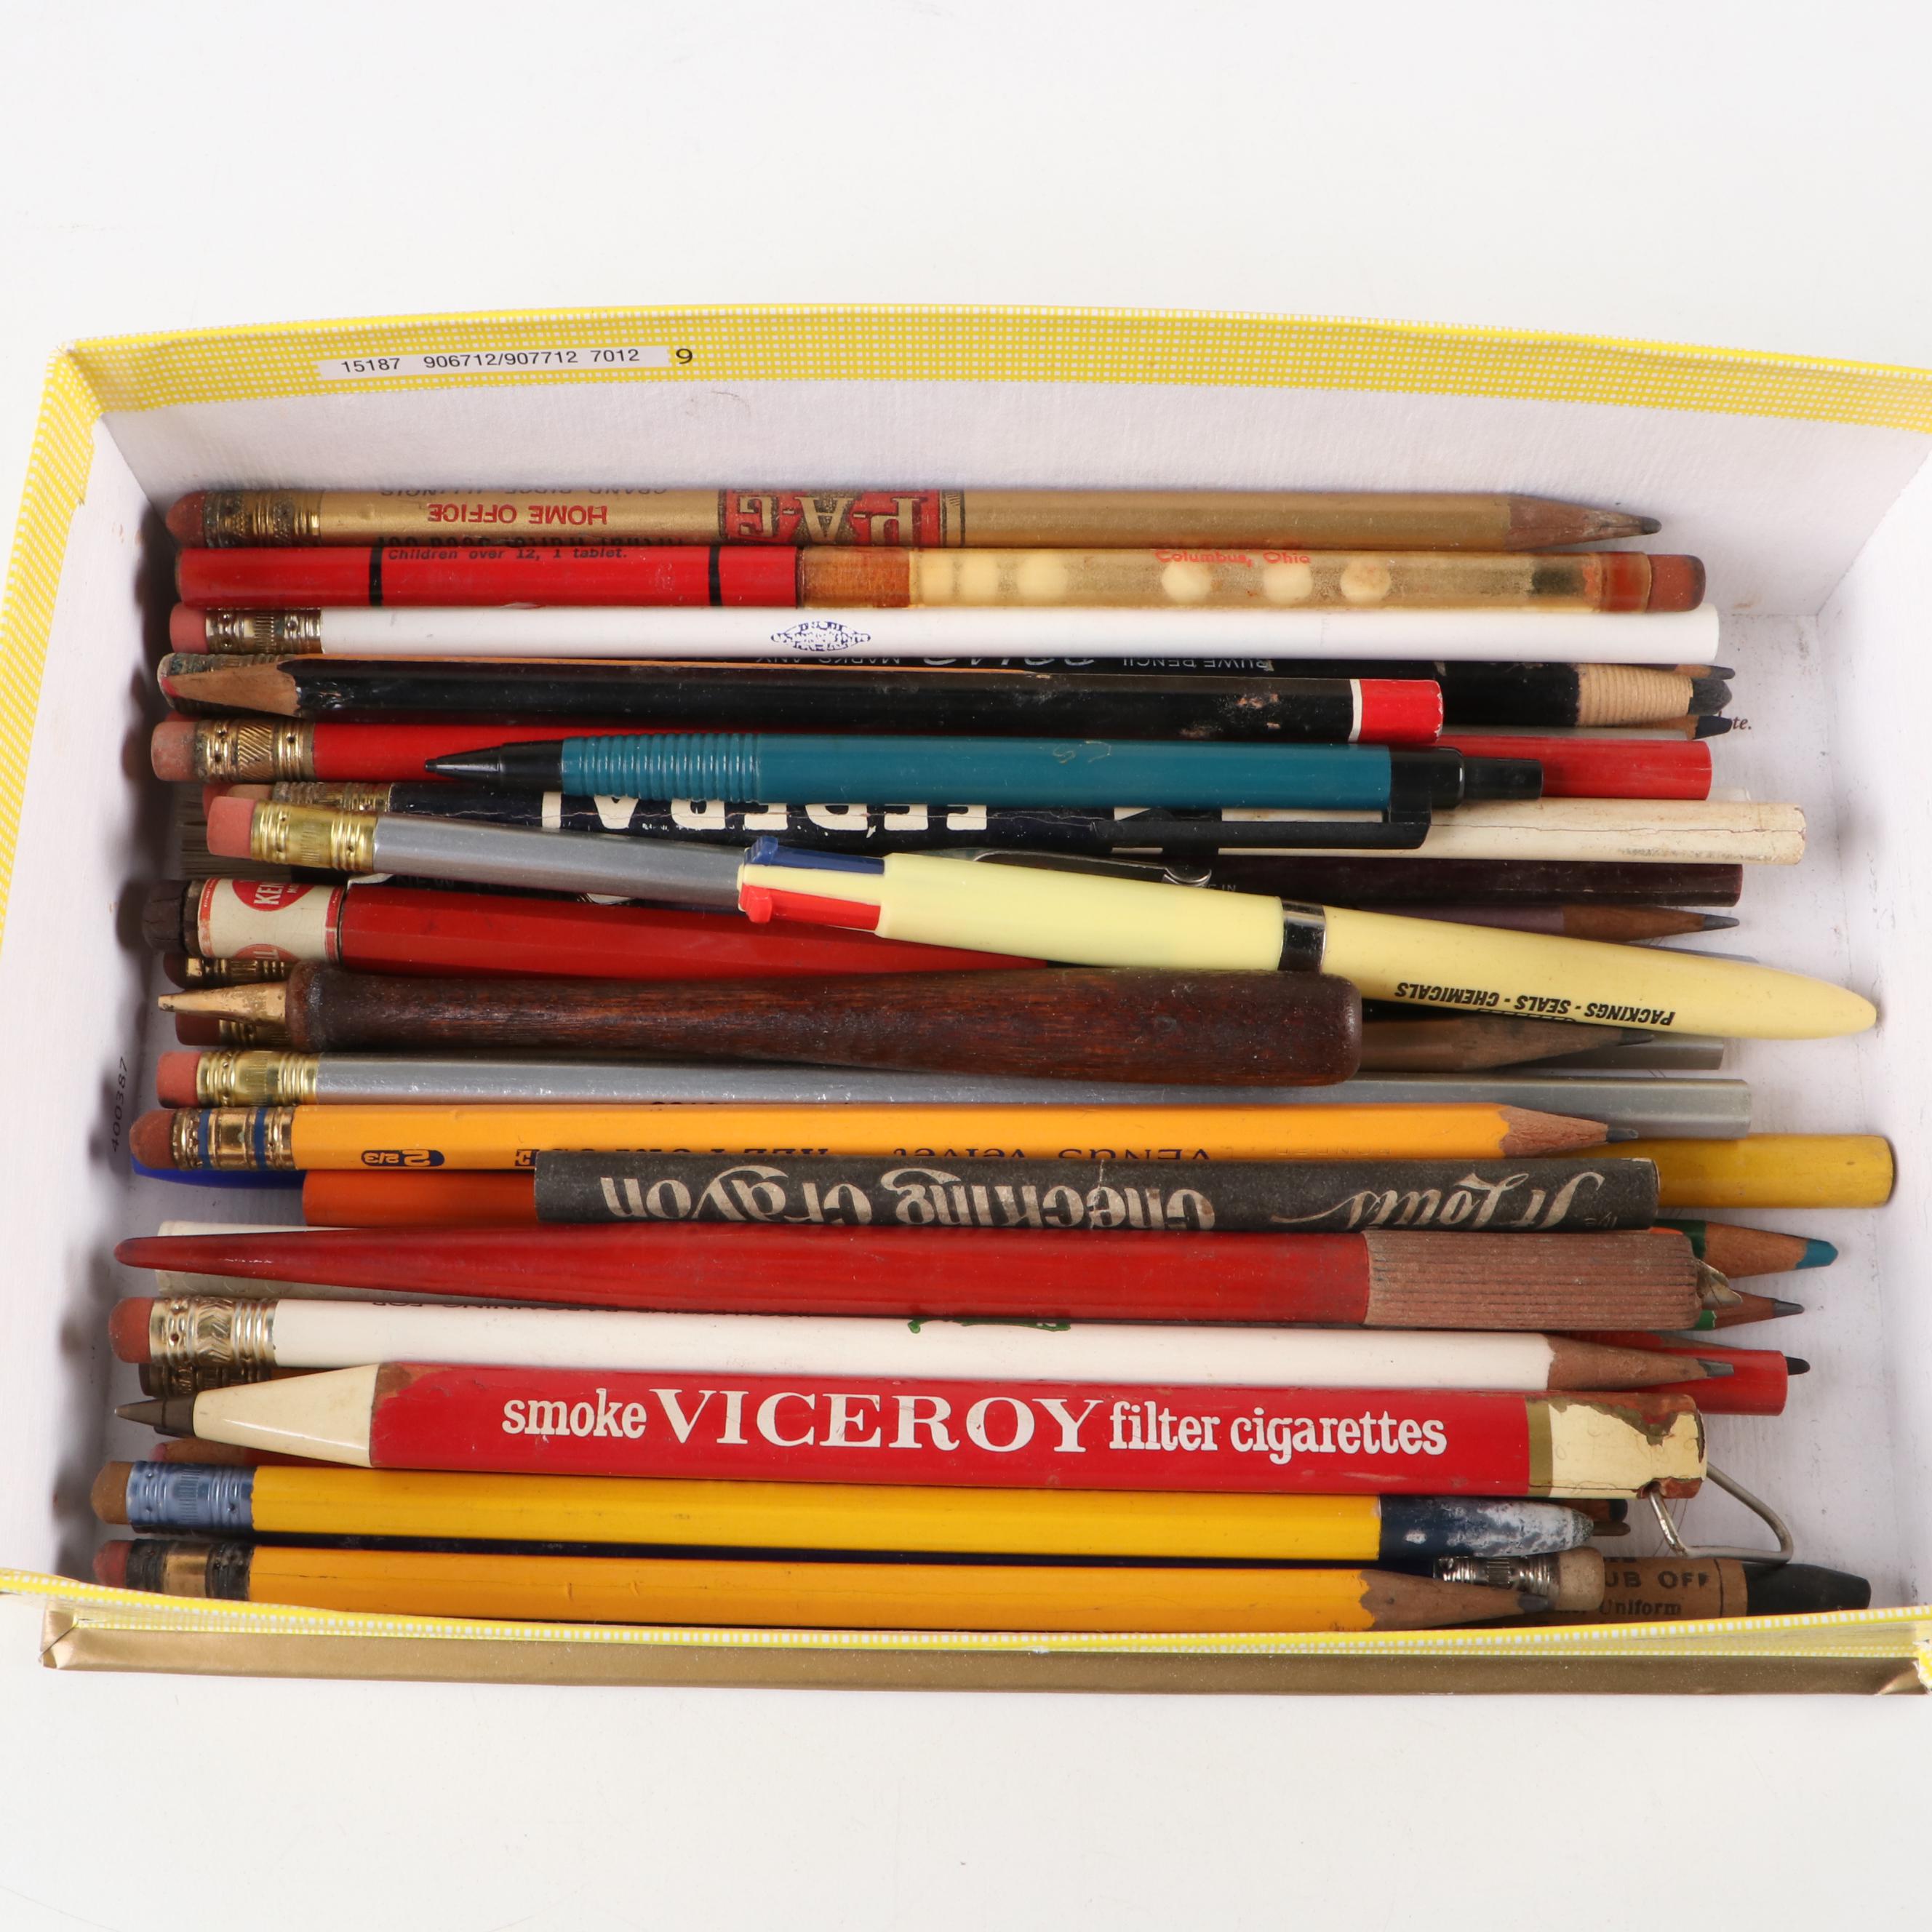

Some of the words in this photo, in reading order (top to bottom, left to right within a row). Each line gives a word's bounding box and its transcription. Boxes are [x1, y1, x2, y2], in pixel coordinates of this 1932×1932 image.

[340, 357, 401, 373] 15187
[423, 350, 578, 370] 906712/907712
[590, 348, 640, 364] 7012
[675, 348, 694, 364] 9
[427, 502, 517, 524] OFFICE
[529, 503, 608, 525] HOME
[388, 548, 458, 560] Children
[468, 551, 506, 560] over
[516, 547, 541, 562] 12,
[572, 547, 628, 559] tablet.
[1261, 550, 1312, 564] Ohio
[1394, 981, 1500, 1007] CHEMICALS
[1514, 994, 1572, 1015] SEALS
[1584, 1002, 1676, 1026] PACKINGS
[111, 1056, 128, 1153] 400387
[502, 1387, 647, 1439] smoke
[649, 1388, 1104, 1452] VICEROY
[1109, 1400, 1221, 1451] filter
[1229, 1406, 1448, 1465] cigarettes
